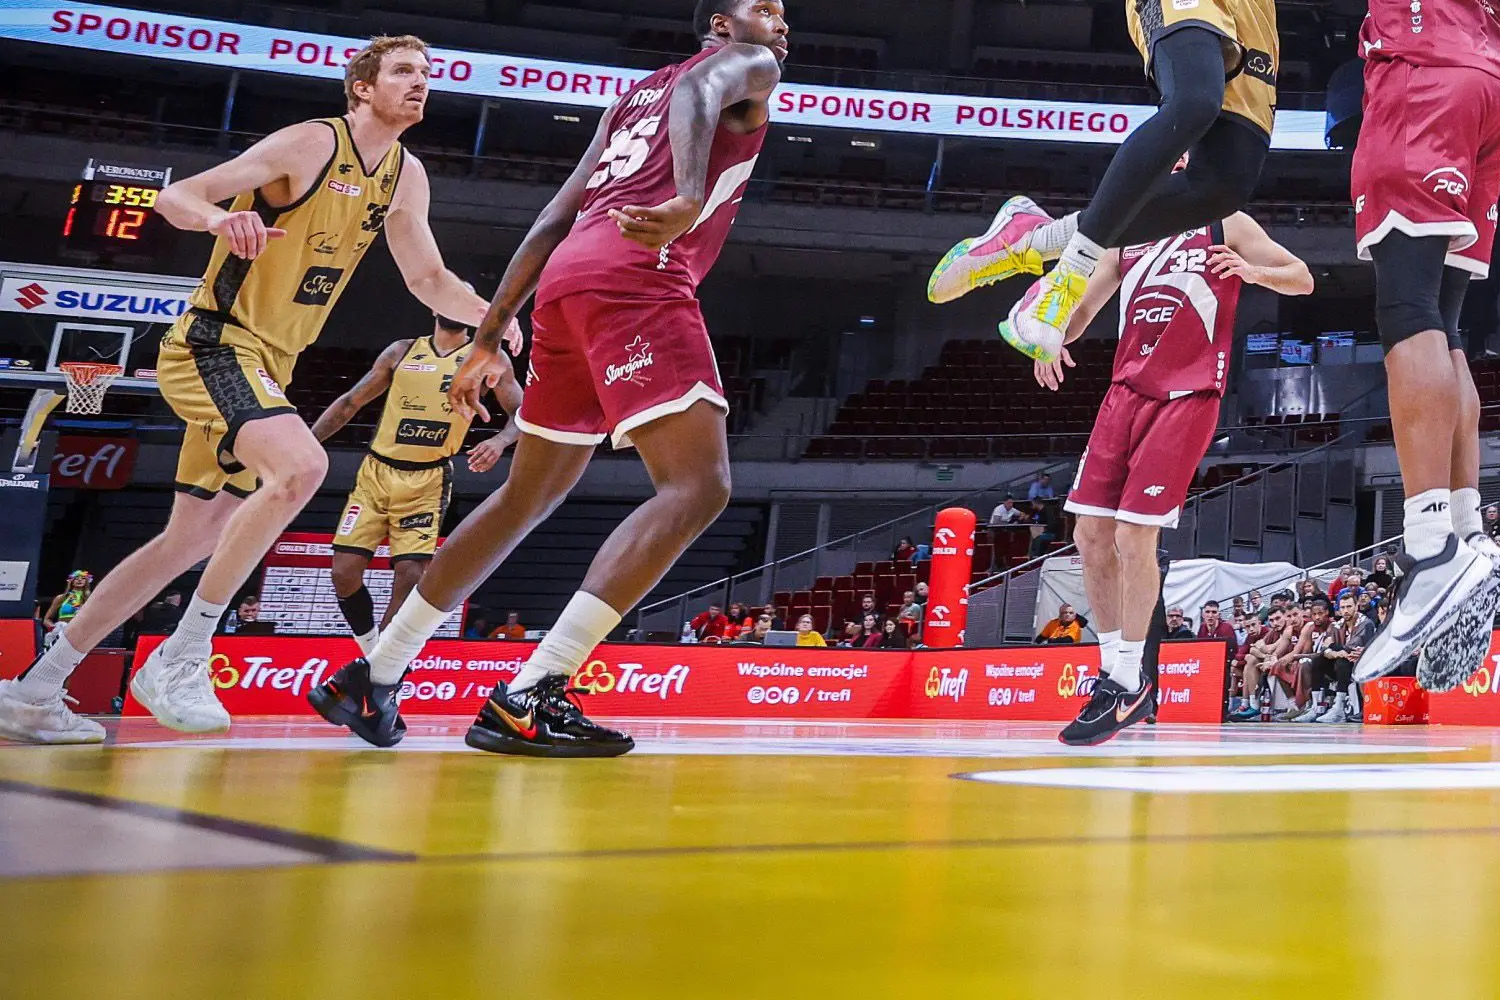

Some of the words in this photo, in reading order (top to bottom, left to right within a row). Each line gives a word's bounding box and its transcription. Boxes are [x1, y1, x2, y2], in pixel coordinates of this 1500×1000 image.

[50, 9, 241, 55] SPONSOR
[270, 39, 472, 82] POLSGO
[777, 92, 931, 123] SPONSOR
[956, 105, 1129, 134] POLSKIEGO
[97, 165, 164, 180] AEROWATCH
[105, 185, 158, 208] 3:59
[1433, 179, 1465, 195] PGE
[106, 209, 146, 240] 12
[1170, 248, 1207, 273] 32
[55, 290, 187, 317] SUZUKI
[1133, 306, 1175, 325] PGE
[605, 353, 654, 386] Stargard
[415, 425, 448, 441] Trefl
[55, 444, 126, 484] refl
[405, 655, 460, 673] pólne
[737, 661, 804, 680] Wspólne
[807, 662, 868, 681] emocje!
[986, 664, 1013, 678] Wspólne
[1015, 662, 1044, 678] emocje!
[1166, 659, 1200, 678] emocje!
[238, 657, 328, 697] Trefl
[617, 663, 690, 700] Trefl
[940, 667, 968, 702] Trefl
[816, 689, 851, 703] trefl
[1171, 687, 1190, 703] trefl
